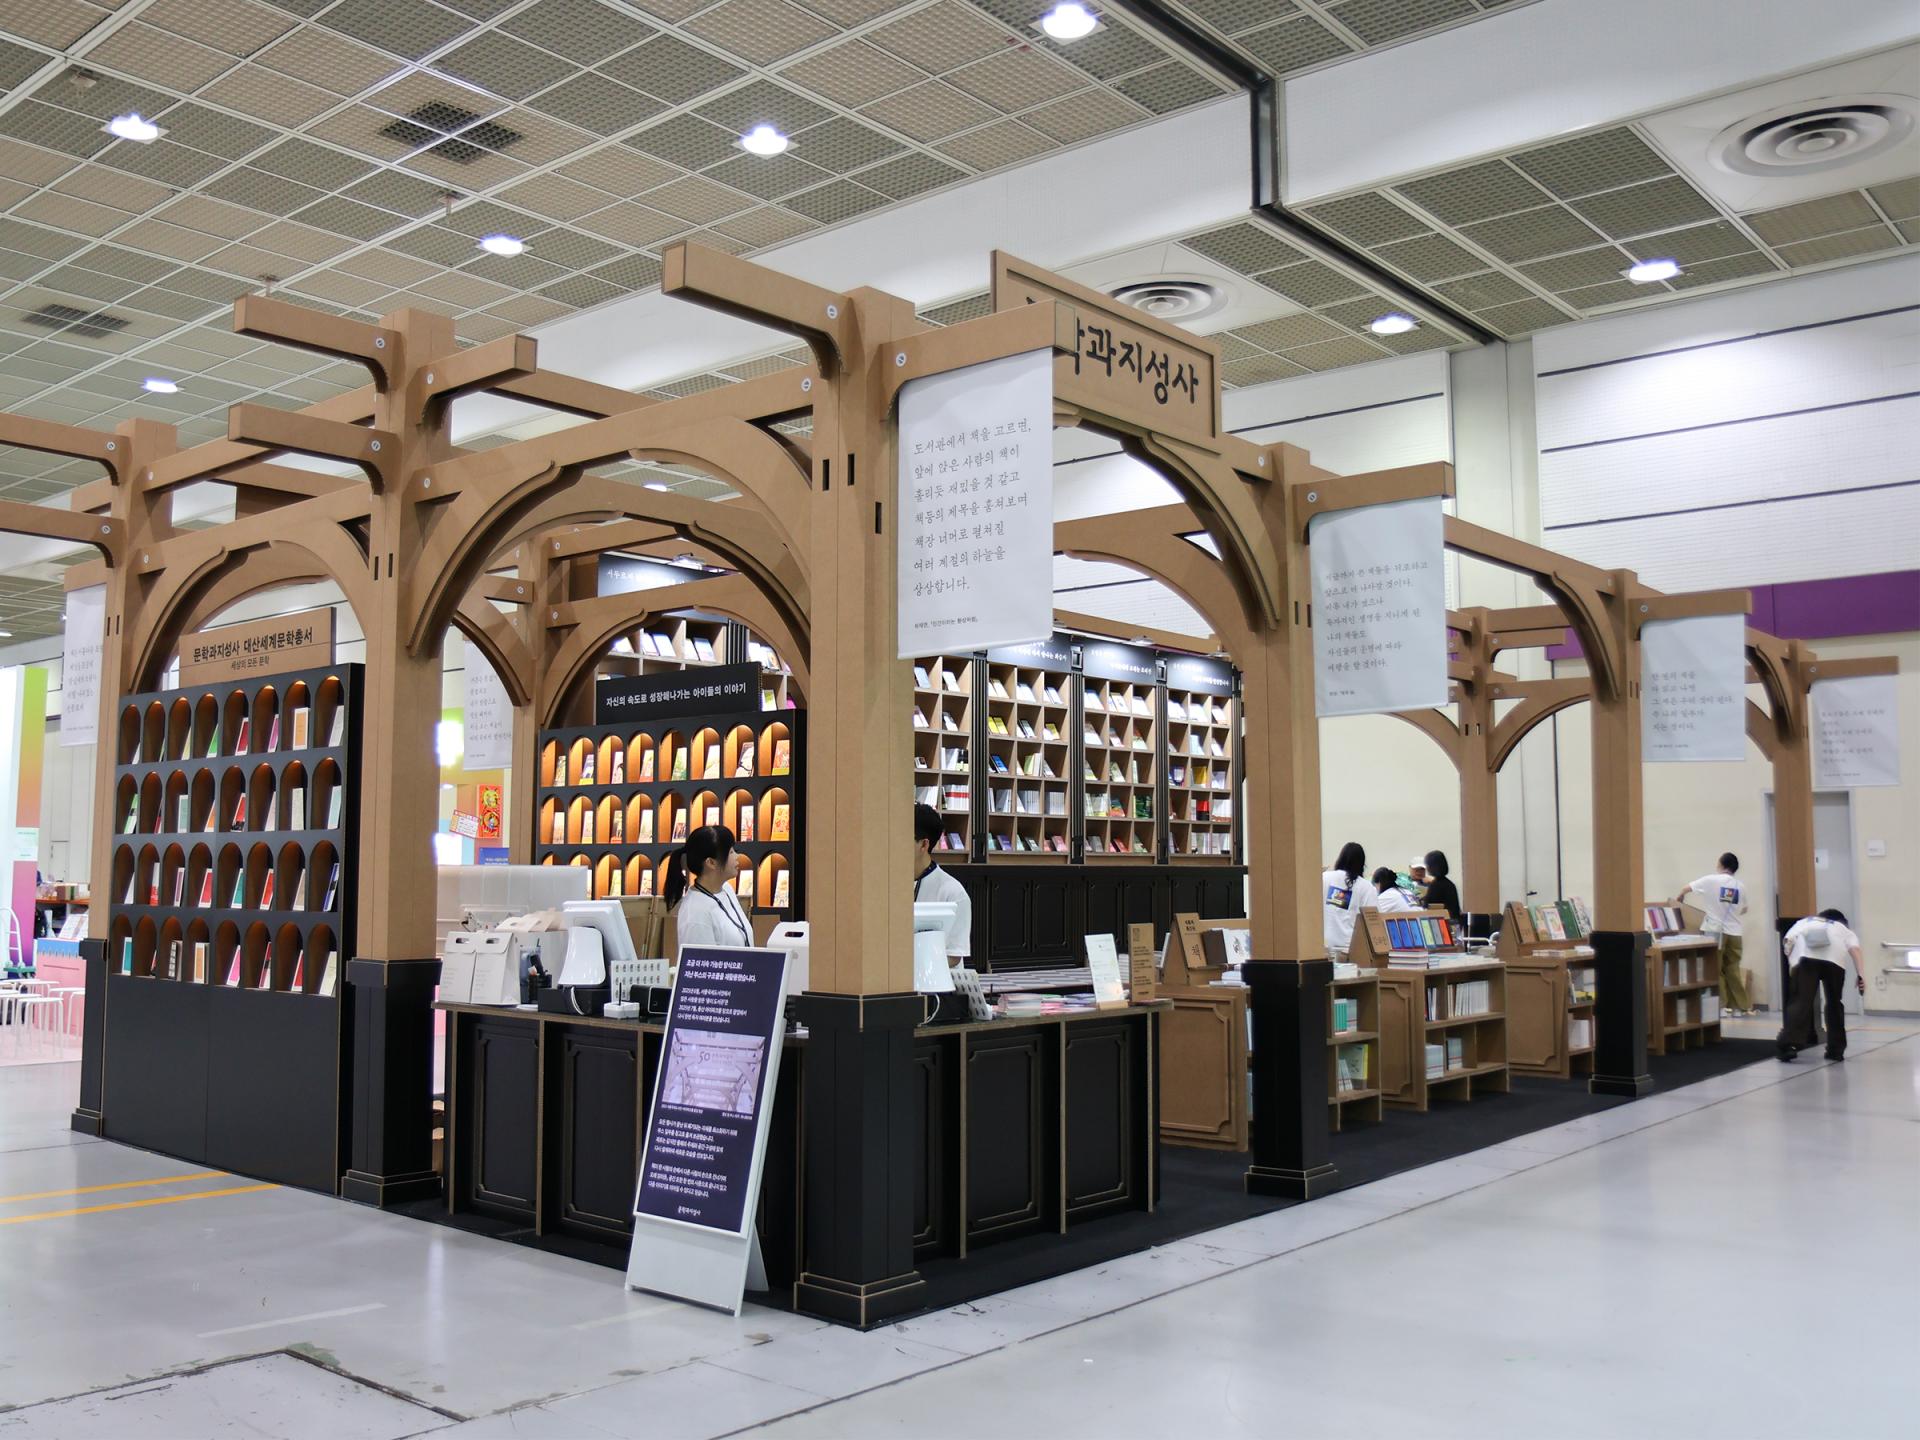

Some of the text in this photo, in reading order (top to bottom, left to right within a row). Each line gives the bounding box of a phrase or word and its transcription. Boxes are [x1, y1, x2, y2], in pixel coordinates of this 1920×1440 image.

[913, 418, 1032, 455] 도서관에서 책을 고르면,
[913, 444, 1020, 479] 앞에 앉은 사람의 책이
[948, 478, 980, 497] 재밌을
[983, 474, 994, 490] 것
[998, 471, 1020, 488] 같고
[915, 493, 1028, 527] 책등의 제목을 훔쳐보며
[914, 533, 935, 550] 책장
[938, 528, 968, 546] 너머로
[913, 545, 1006, 573] 여러 계절의 하늘을
[913, 576, 970, 598] 상상합니다.
[1324, 586, 1349, 597] 앞으로
[193, 626, 313, 663] 문학과지성사 대산세계문학총서
[231, 659, 247, 671] 세상의
[247, 657, 258, 669] 모든
[606, 682, 747, 708] 자신의 속도로 성장해나가는 아이들의 이야기
